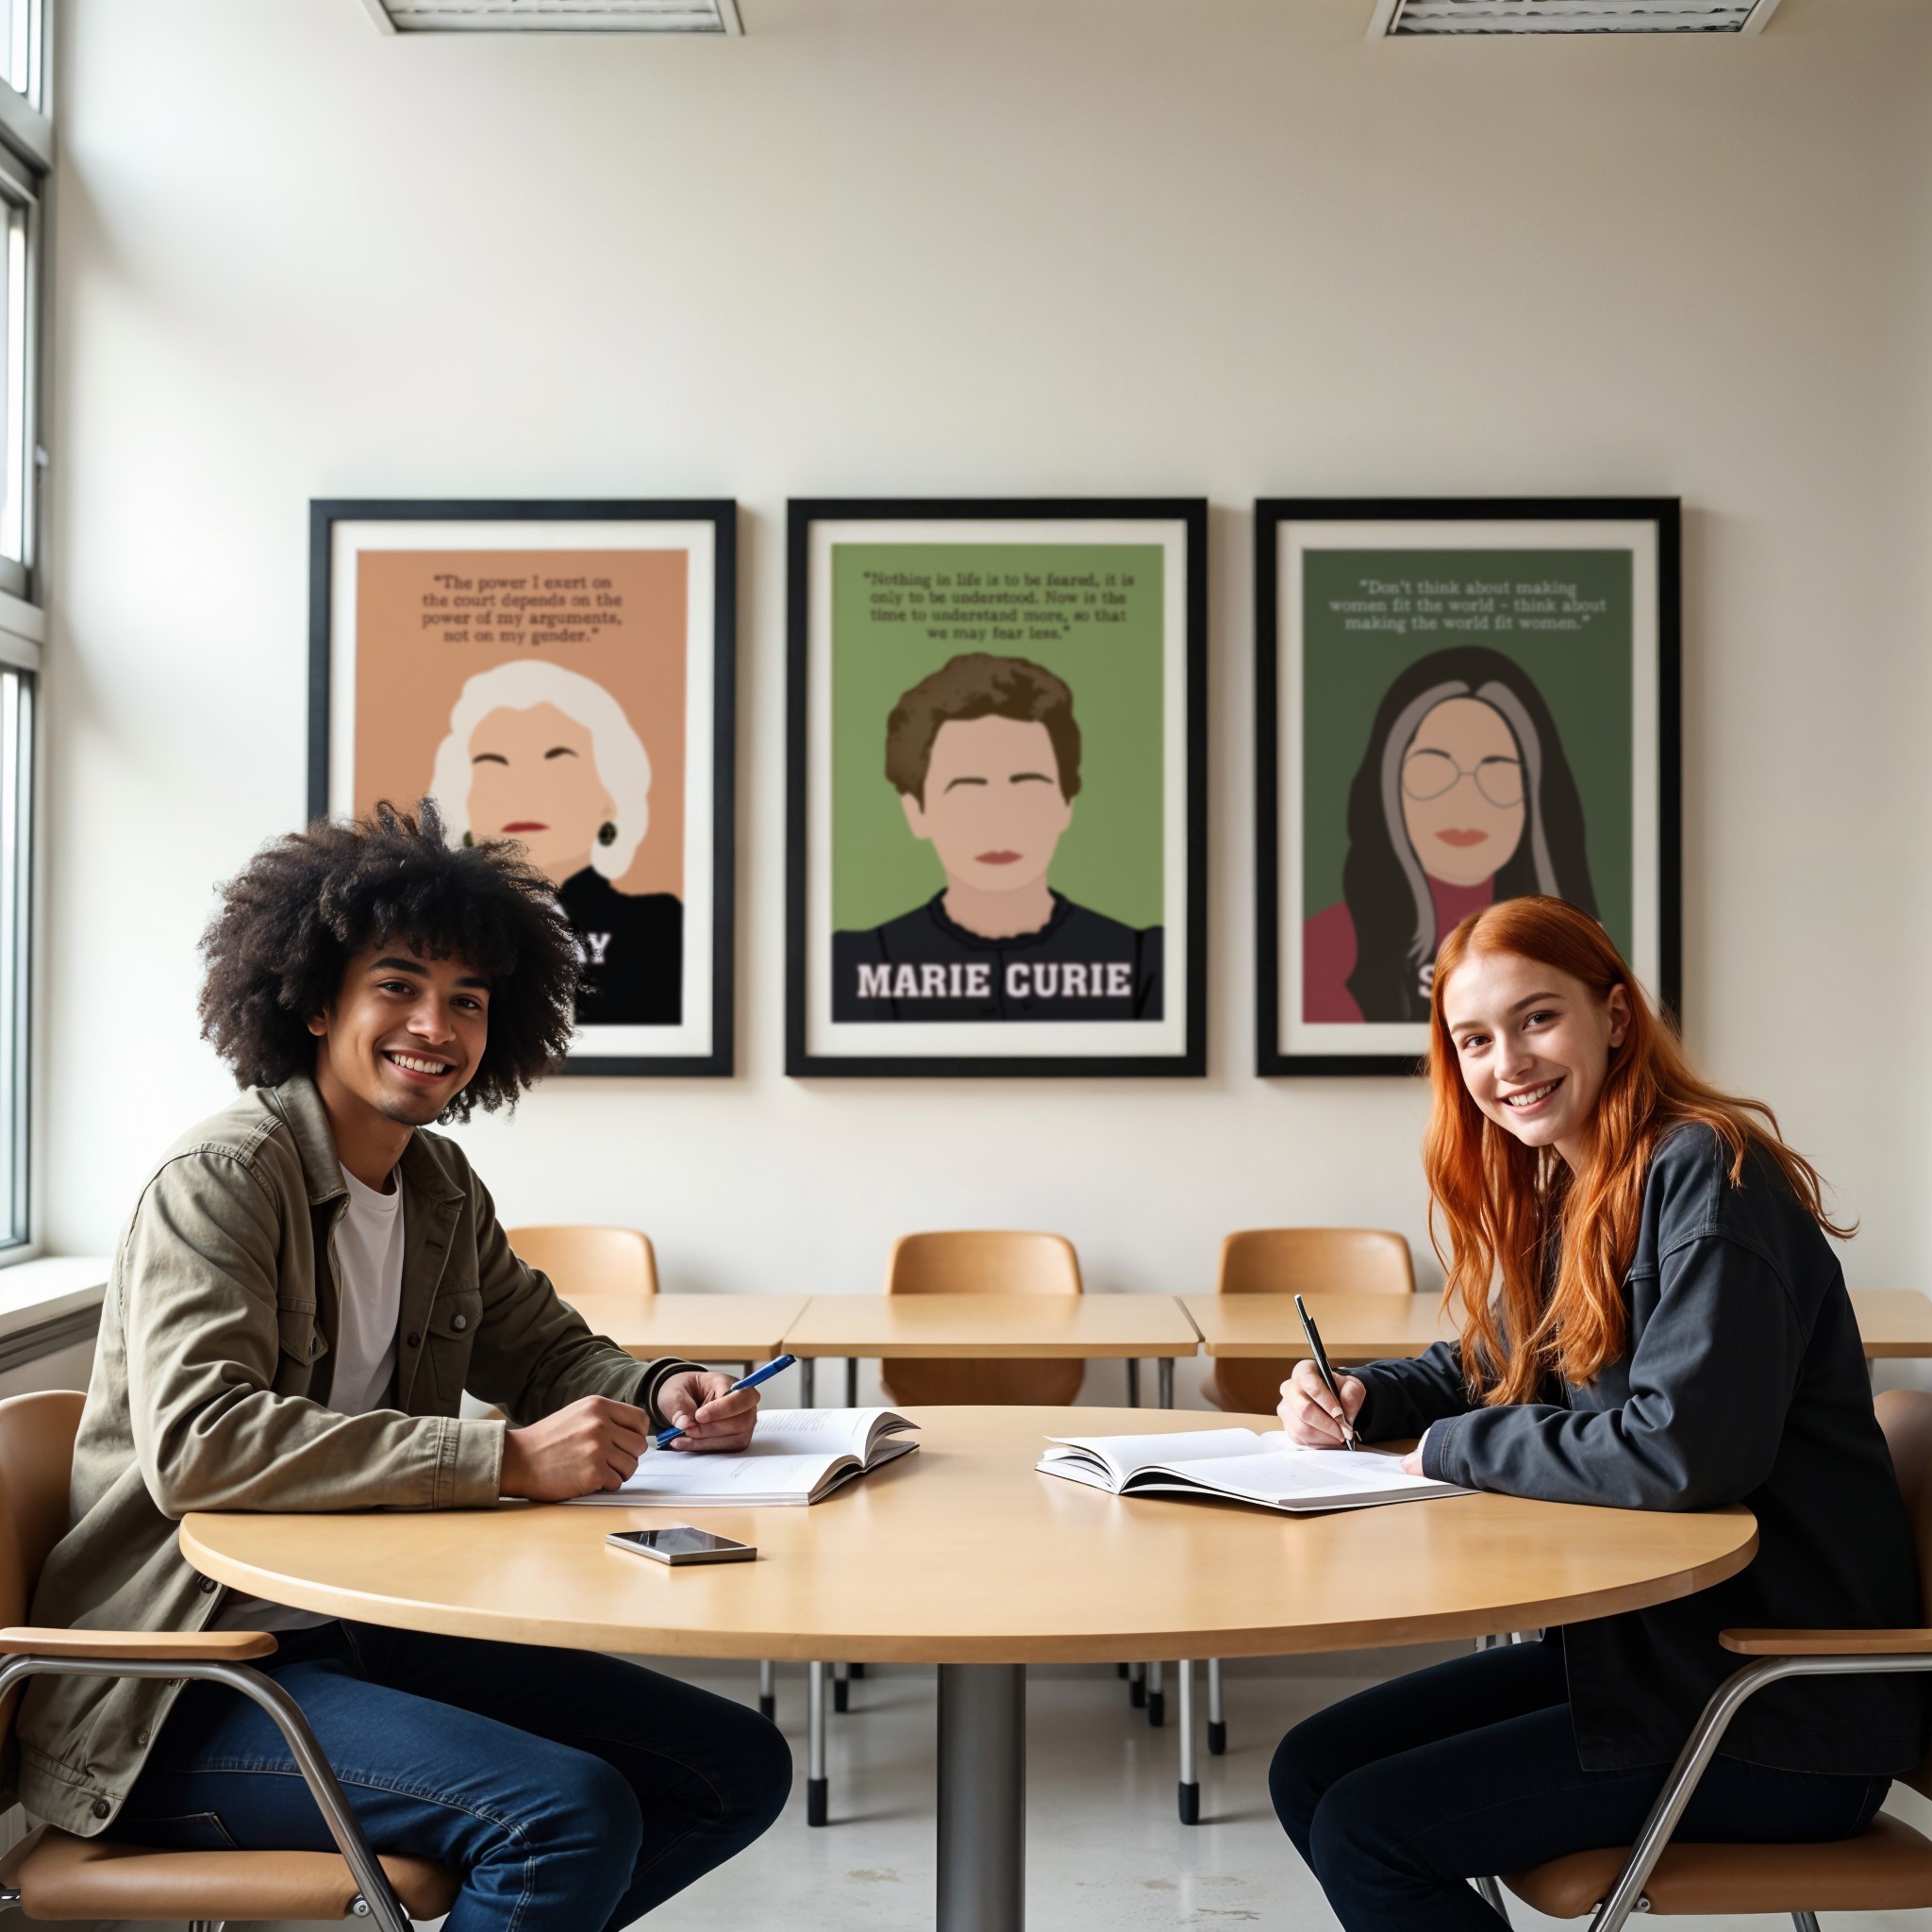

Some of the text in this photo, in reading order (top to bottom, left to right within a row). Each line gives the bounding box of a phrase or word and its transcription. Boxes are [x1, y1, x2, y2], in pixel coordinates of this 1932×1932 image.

[477, 578, 527, 593] power
[532, 575, 540, 590] I
[543, 576, 588, 590] exert
[591, 578, 612, 590] on
[937, 573, 952, 587] in
[957, 573, 982, 587] life
[987, 575, 1000, 587] is
[1005, 574, 1020, 587] to
[1024, 573, 1041, 587] be
[1046, 572, 1101, 589] feared,
[1106, 573, 1117, 587] it
[1122, 573, 1135, 587] is
[1417, 580, 1460, 595] think
[1465, 580, 1510, 595] about
[1515, 580, 1577, 598] making
[423, 593, 623, 611] the court depends on the
[870, 591, 1127, 607] only to be understood. Now is the
[1328, 600, 1387, 612] women
[1392, 597, 1411, 612] fit
[1417, 598, 1443, 612] the
[1448, 597, 1495, 612] world
[1513, 598, 1557, 612] think
[1561, 597, 1607, 613] about
[422, 611, 623, 629] power of my arguments,
[870, 608, 1127, 625] time to understand more, so that
[1344, 615, 1407, 634] making
[1411, 615, 1439, 630] the
[1443, 615, 1490, 630] world
[1493, 615, 1514, 630] fit
[443, 629, 470, 643] not
[475, 631, 494, 643] on
[499, 631, 525, 646] my
[925, 628, 948, 641] we
[953, 628, 987, 642] may
[992, 625, 1024, 641] fear
[857, 963, 1131, 998] MARIE CURIE
